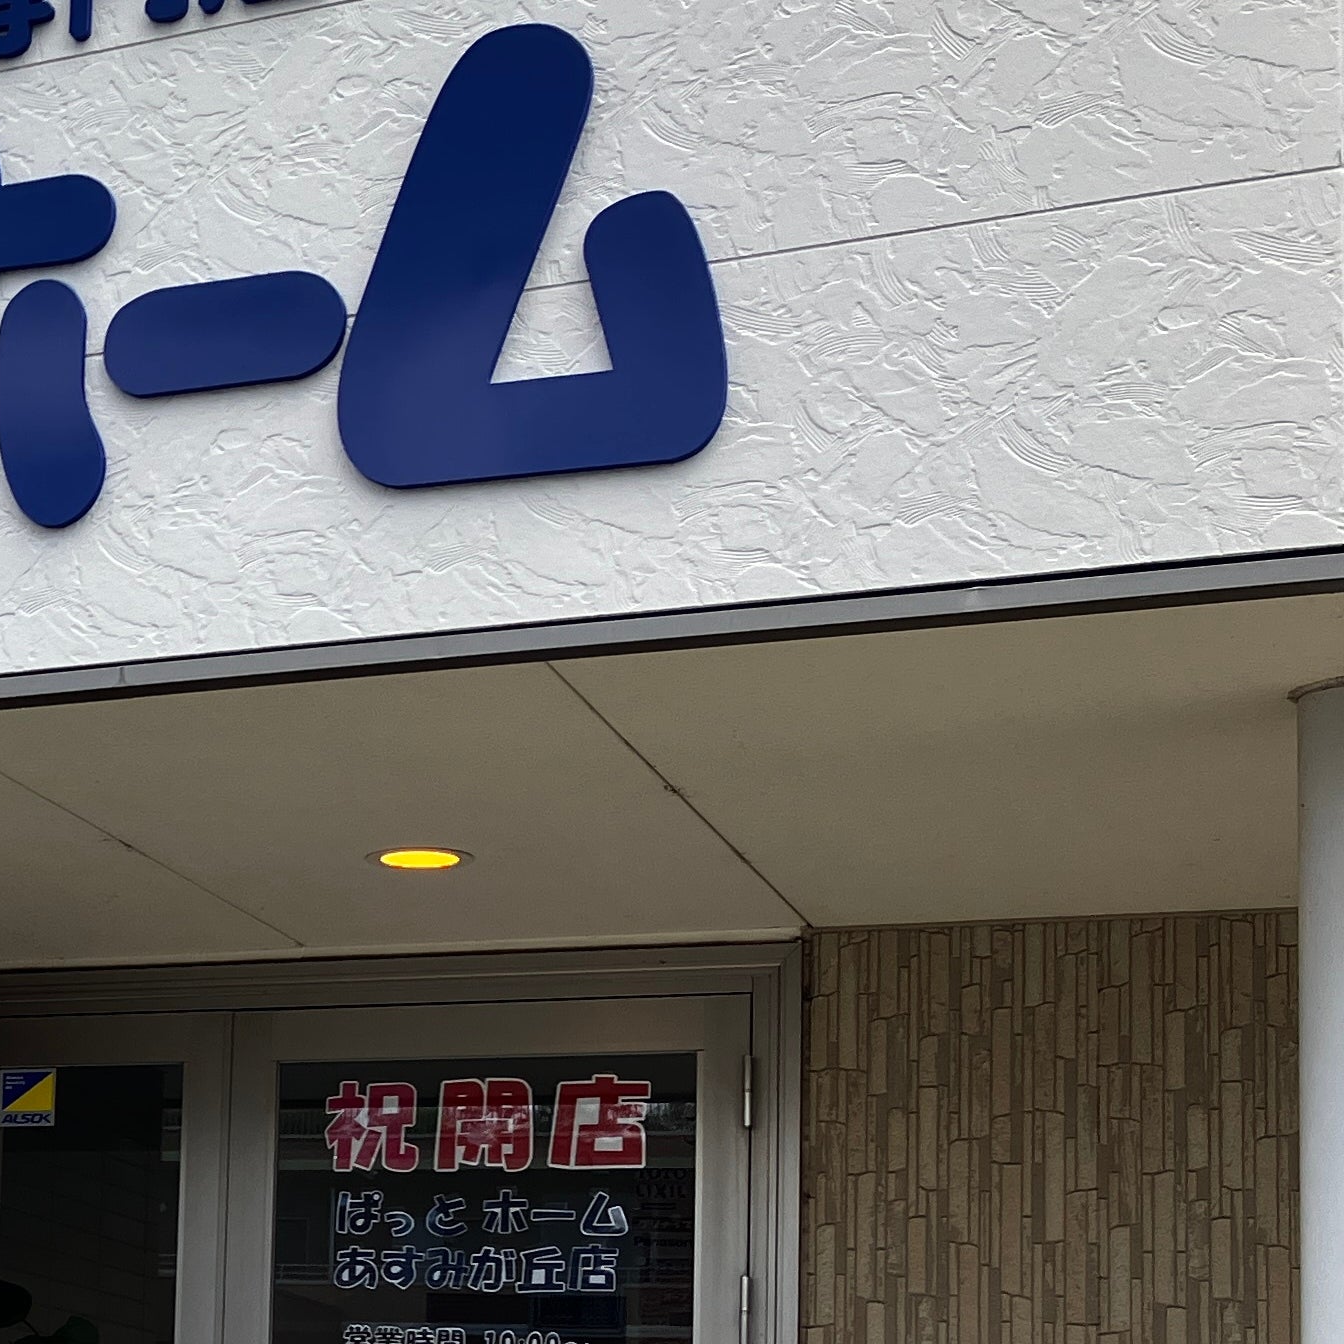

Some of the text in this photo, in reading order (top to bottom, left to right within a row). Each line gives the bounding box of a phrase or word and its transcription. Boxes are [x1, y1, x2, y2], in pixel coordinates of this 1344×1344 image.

[1, 1113, 52, 1124] ALSOK
[325, 1075, 652, 1172] 祝開店
[333, 1244, 620, 1294] あすみが丘店
